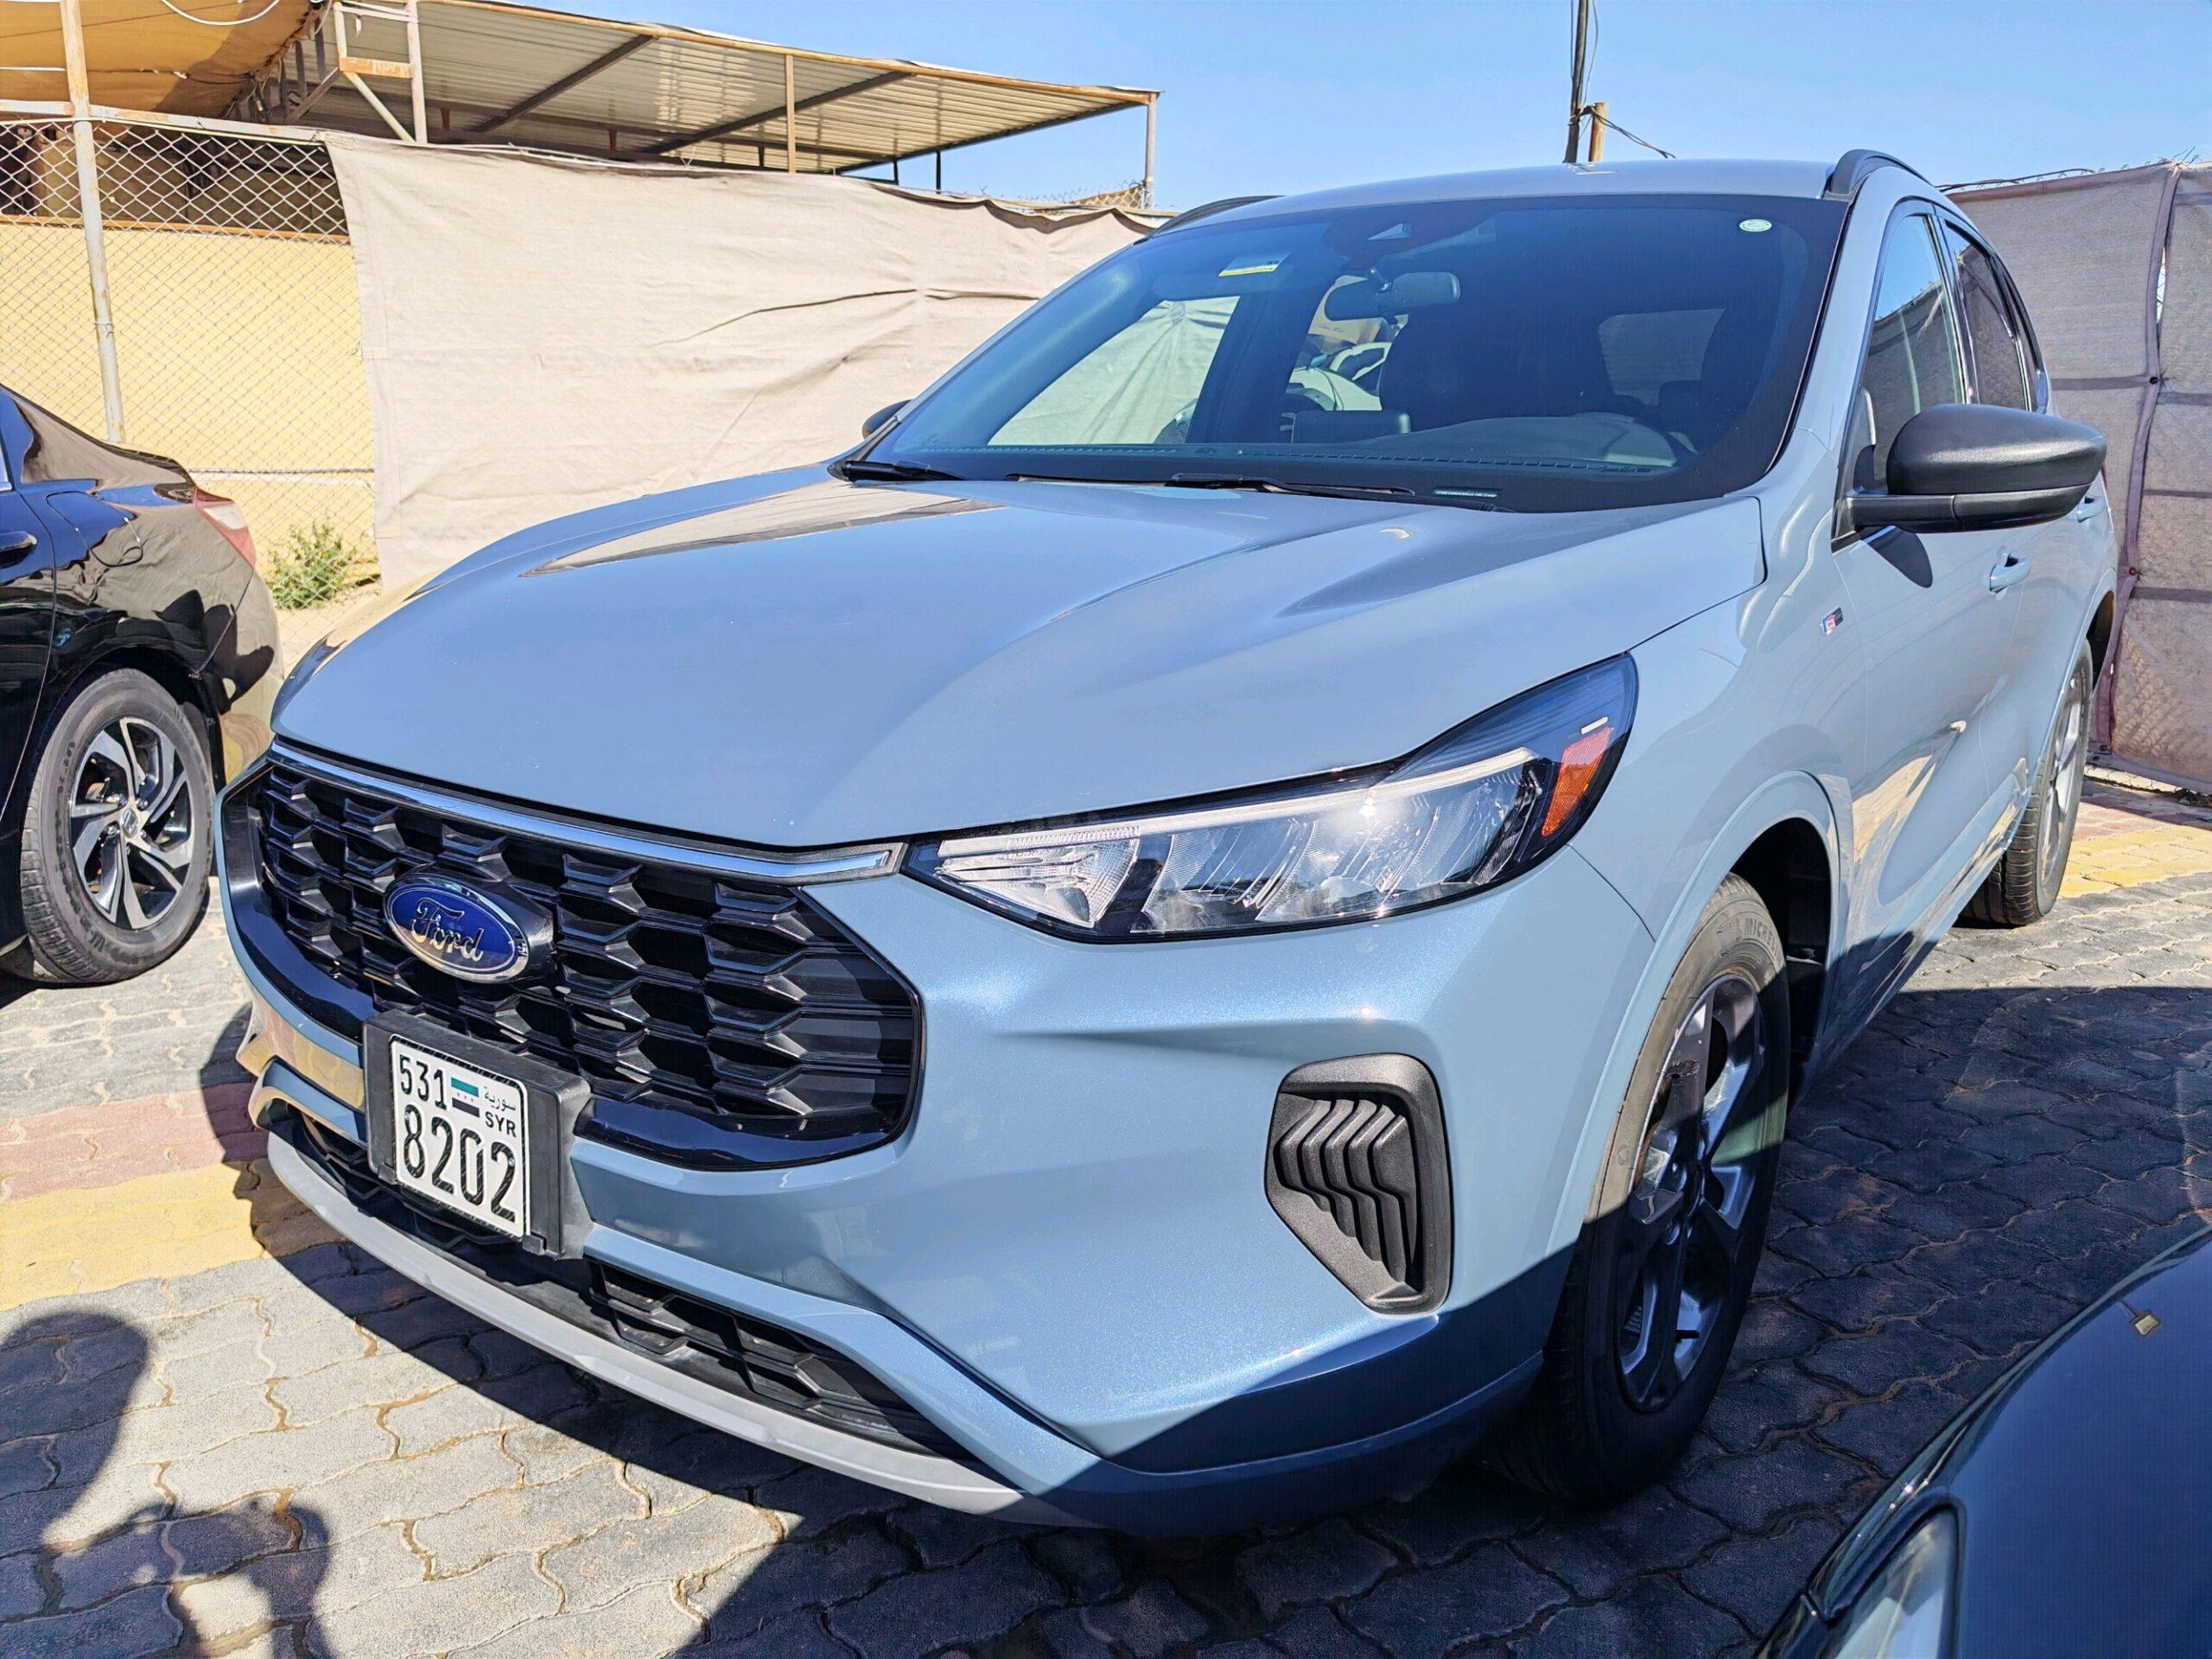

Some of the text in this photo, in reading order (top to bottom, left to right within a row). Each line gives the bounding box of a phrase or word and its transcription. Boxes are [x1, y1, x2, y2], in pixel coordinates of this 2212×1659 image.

[410, 897, 485, 962] Ford
[399, 1053, 448, 1111] 531
[484, 1085, 516, 1112] سورية
[485, 1110, 517, 1138] SYR
[404, 1103, 516, 1224] 8202
